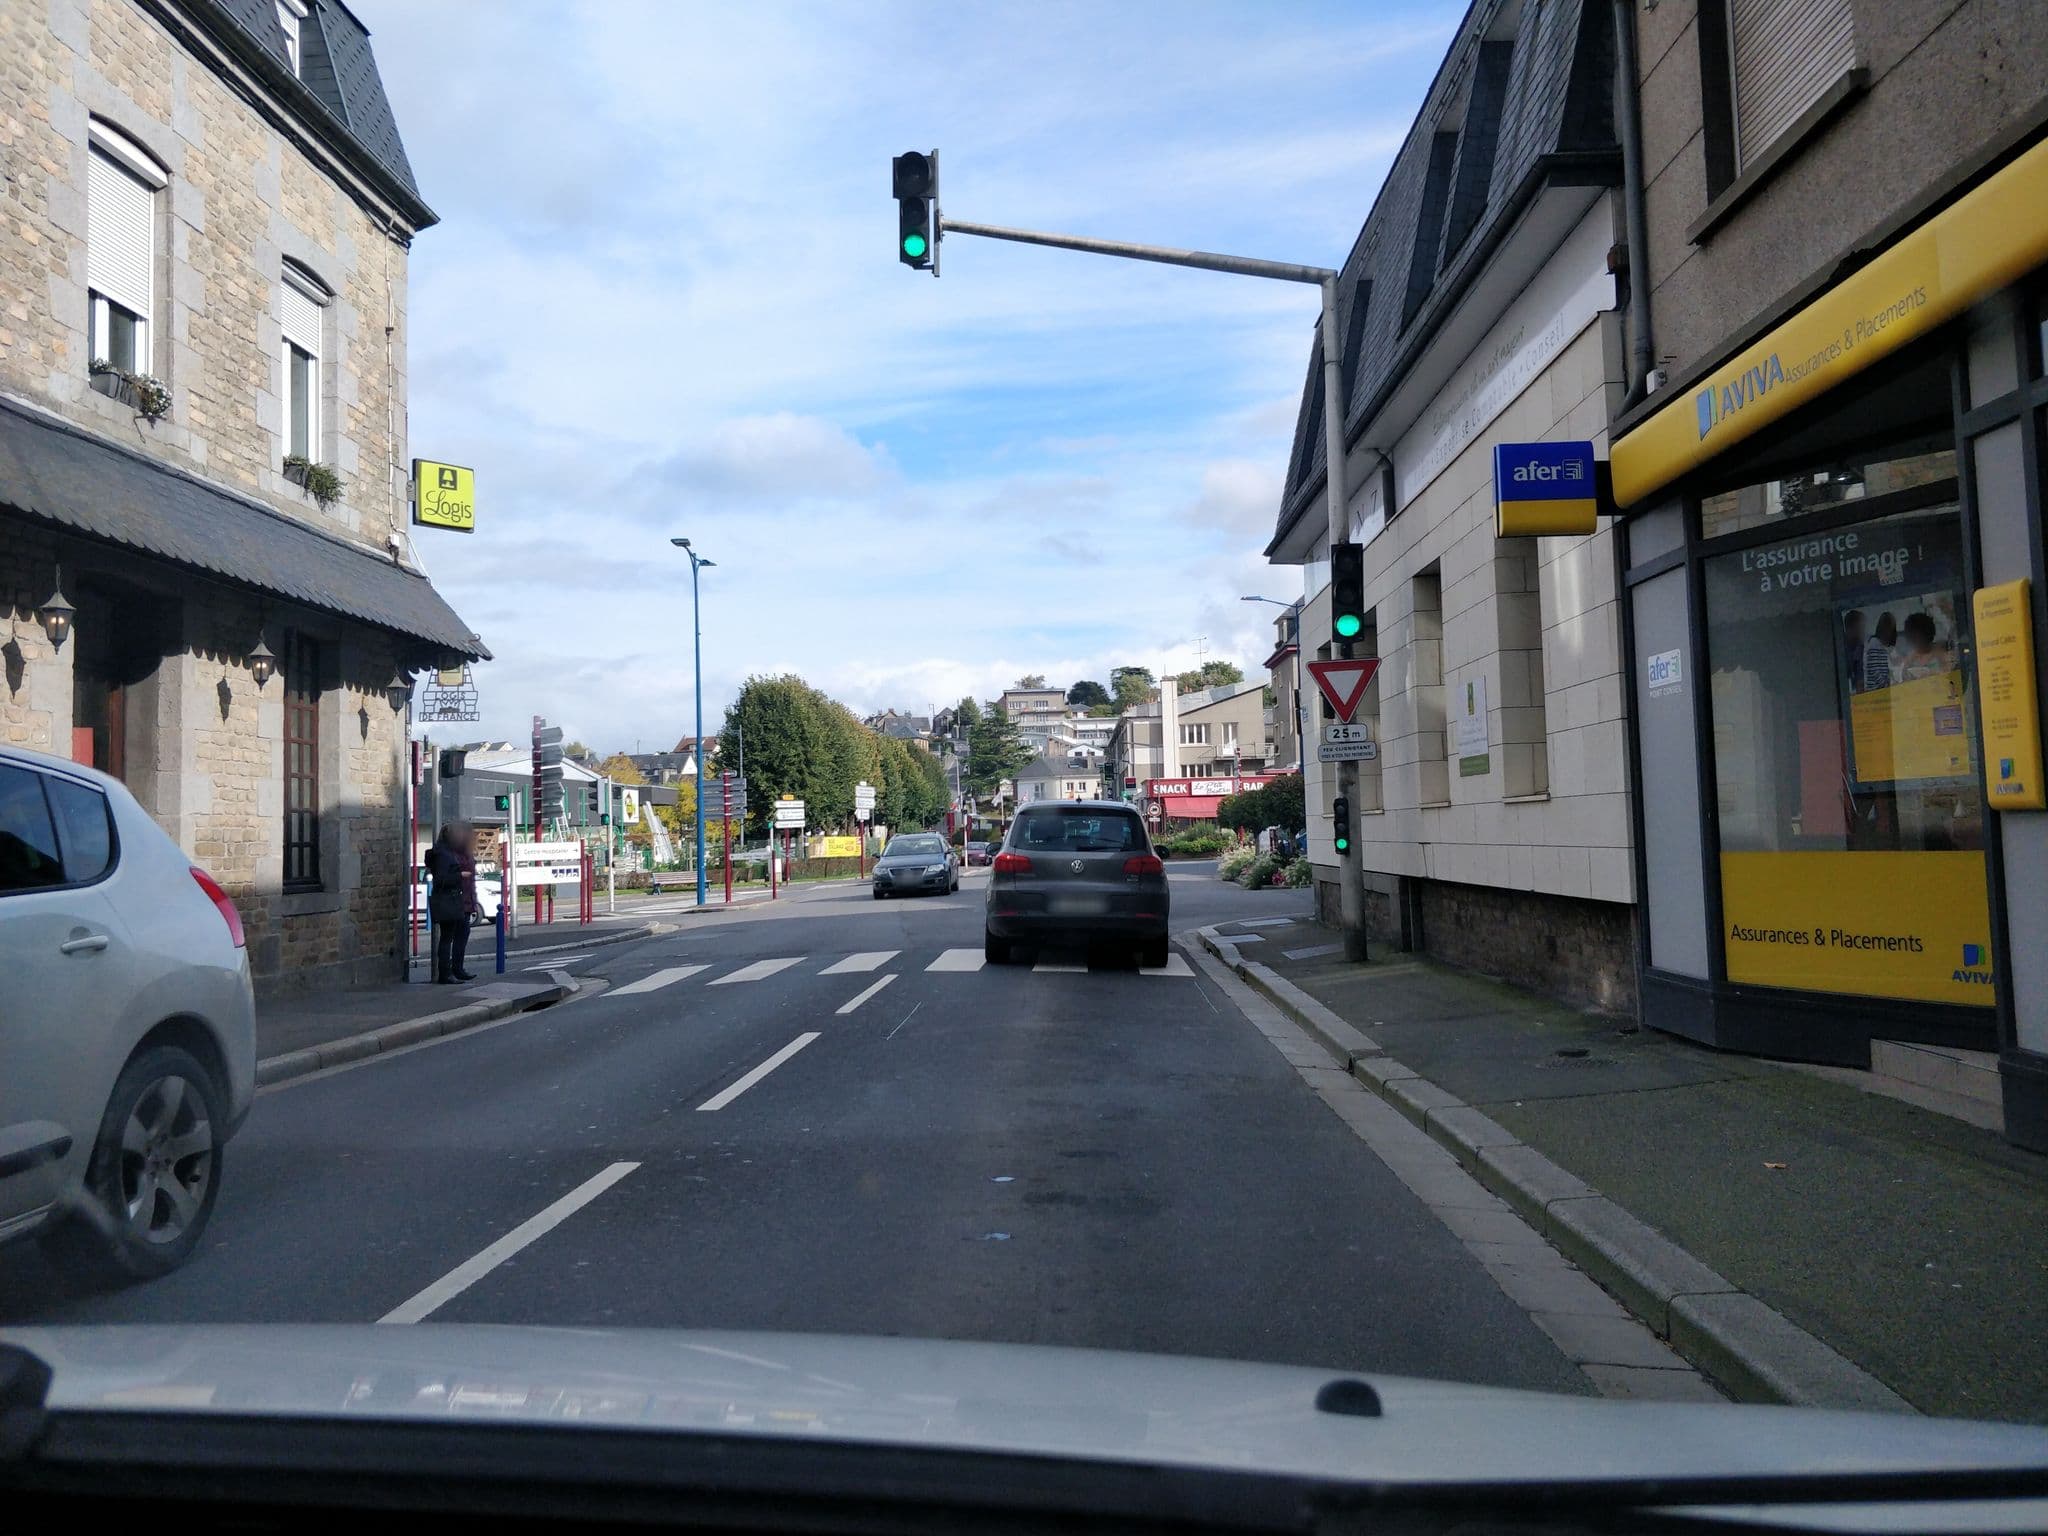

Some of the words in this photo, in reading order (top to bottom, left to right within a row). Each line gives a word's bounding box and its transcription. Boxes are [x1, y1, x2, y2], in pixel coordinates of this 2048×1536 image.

[1785, 342, 1842, 384] Assurances
[1844, 328, 1854, 351] &
[1855, 286, 1928, 344] Placements
[1721, 352, 1785, 421] AVIVA
[1513, 461, 1562, 482] afer
[424, 490, 472, 523] Logis
[1742, 533, 1859, 572] L'assurance
[1760, 571, 1772, 593] à
[1777, 562, 1833, 589] votre
[1839, 547, 1910, 577] image
[1917, 545, 1924, 561] !
[1650, 656, 1671, 682] afer
[422, 713, 434, 721] DE
[437, 713, 476, 721] FRANCE
[1332, 728, 1349, 739] 25
[1153, 784, 1187, 794] SNACK
[1243, 782, 1265, 791] BAR
[1730, 924, 1809, 946] Assurances
[1814, 928, 1826, 947] &
[1831, 929, 1923, 953] Placements
